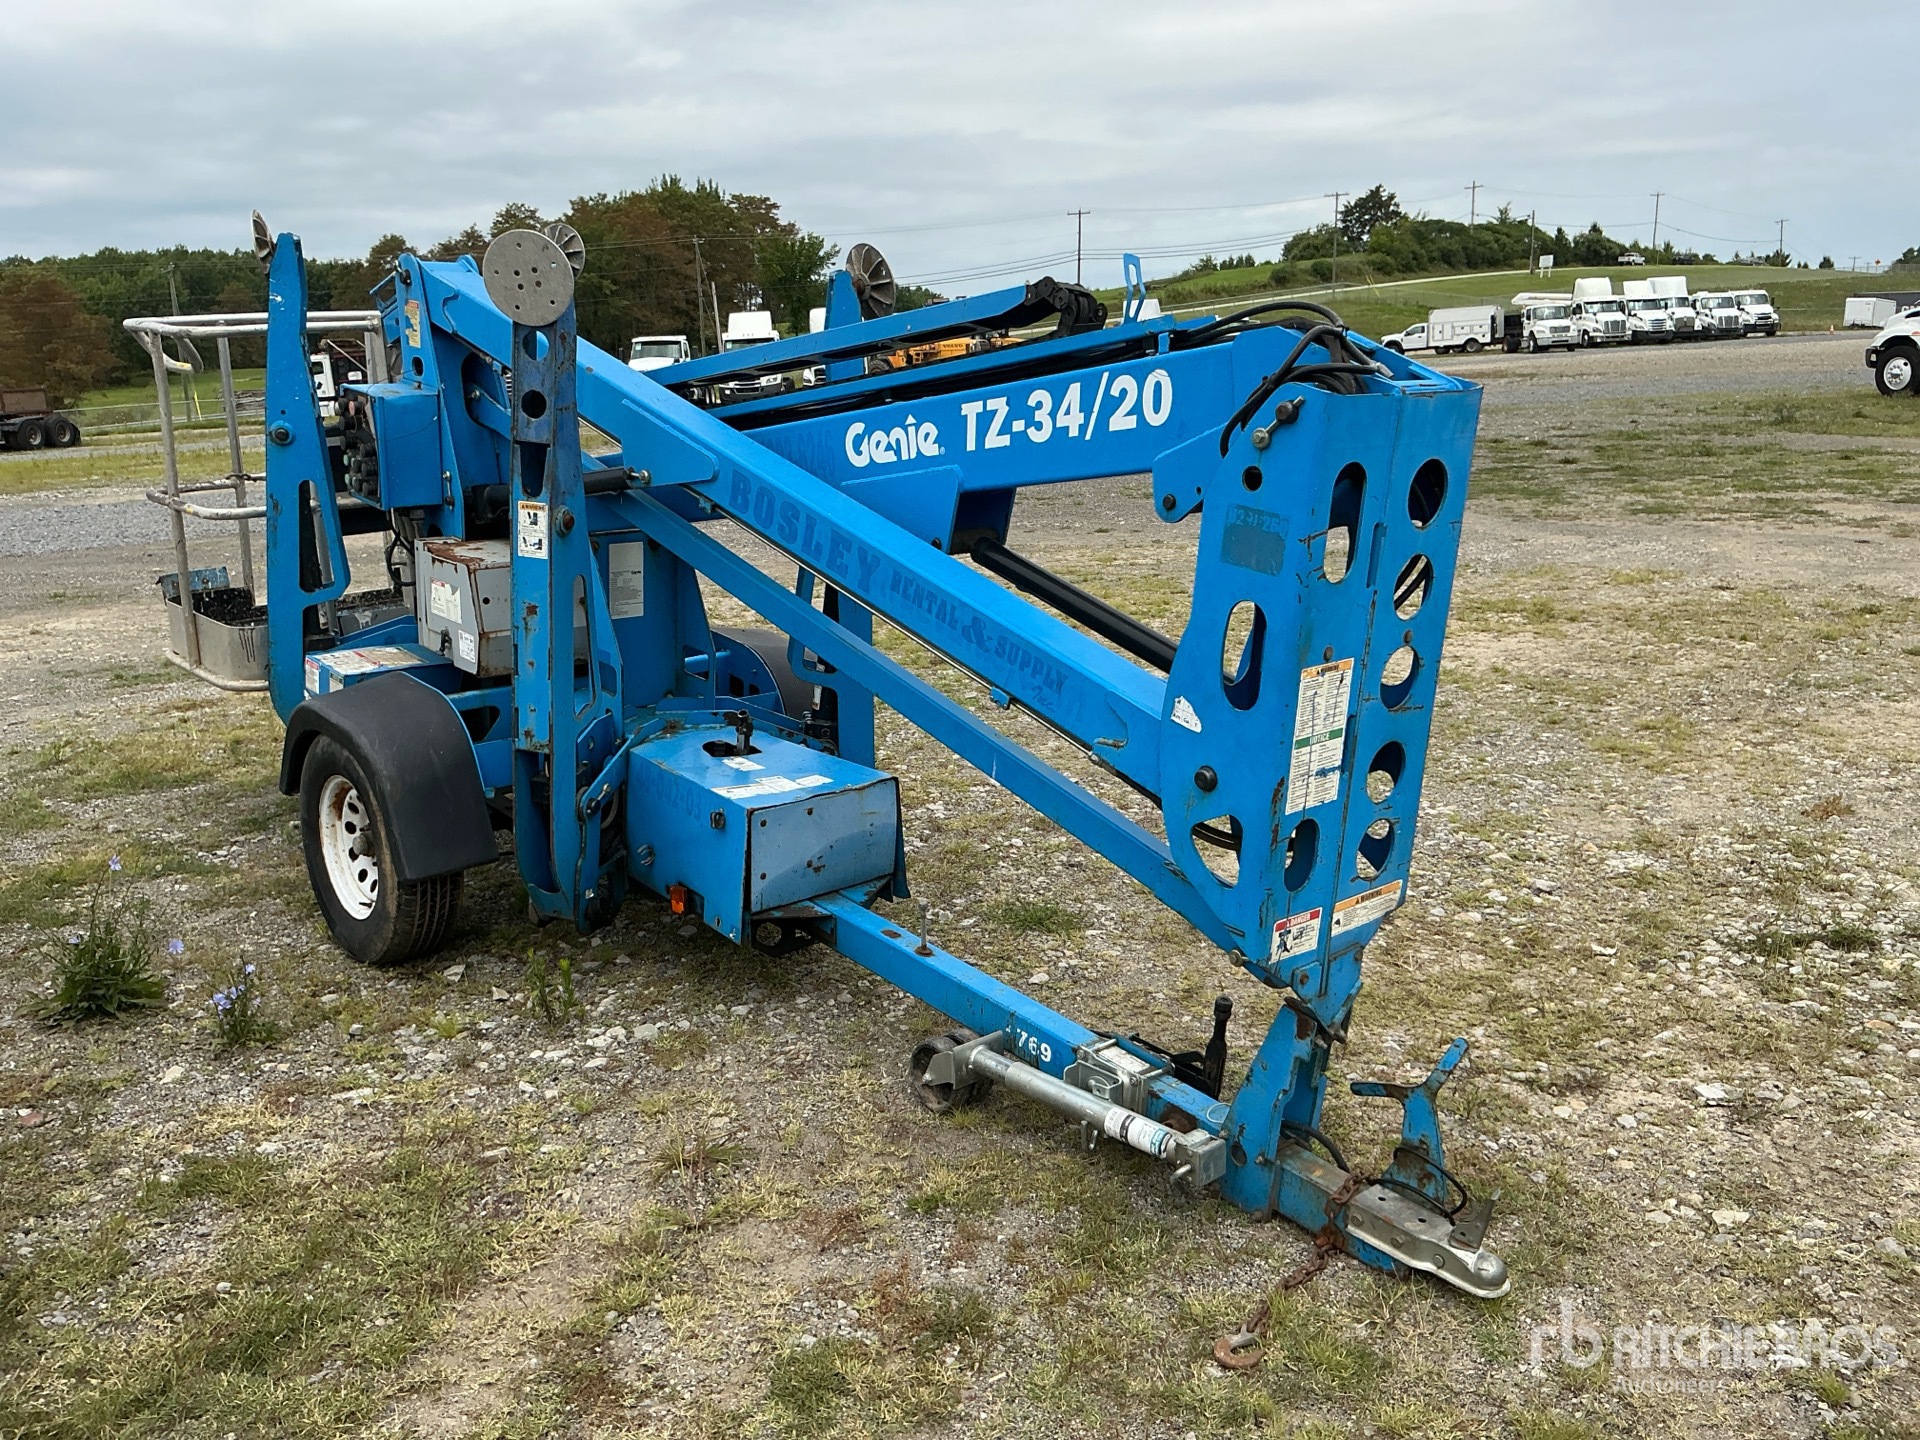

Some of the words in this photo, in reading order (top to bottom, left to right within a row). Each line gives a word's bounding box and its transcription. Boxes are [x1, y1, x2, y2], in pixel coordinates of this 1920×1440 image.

[845, 413, 940, 468] Genie
[961, 368, 1173, 452] TZ-34/20
[730, 468, 882, 595] BOSLEY
[889, 568, 958, 632] RENTAL
[960, 616, 993, 653] &
[995, 635, 1069, 698] SUPPLY
